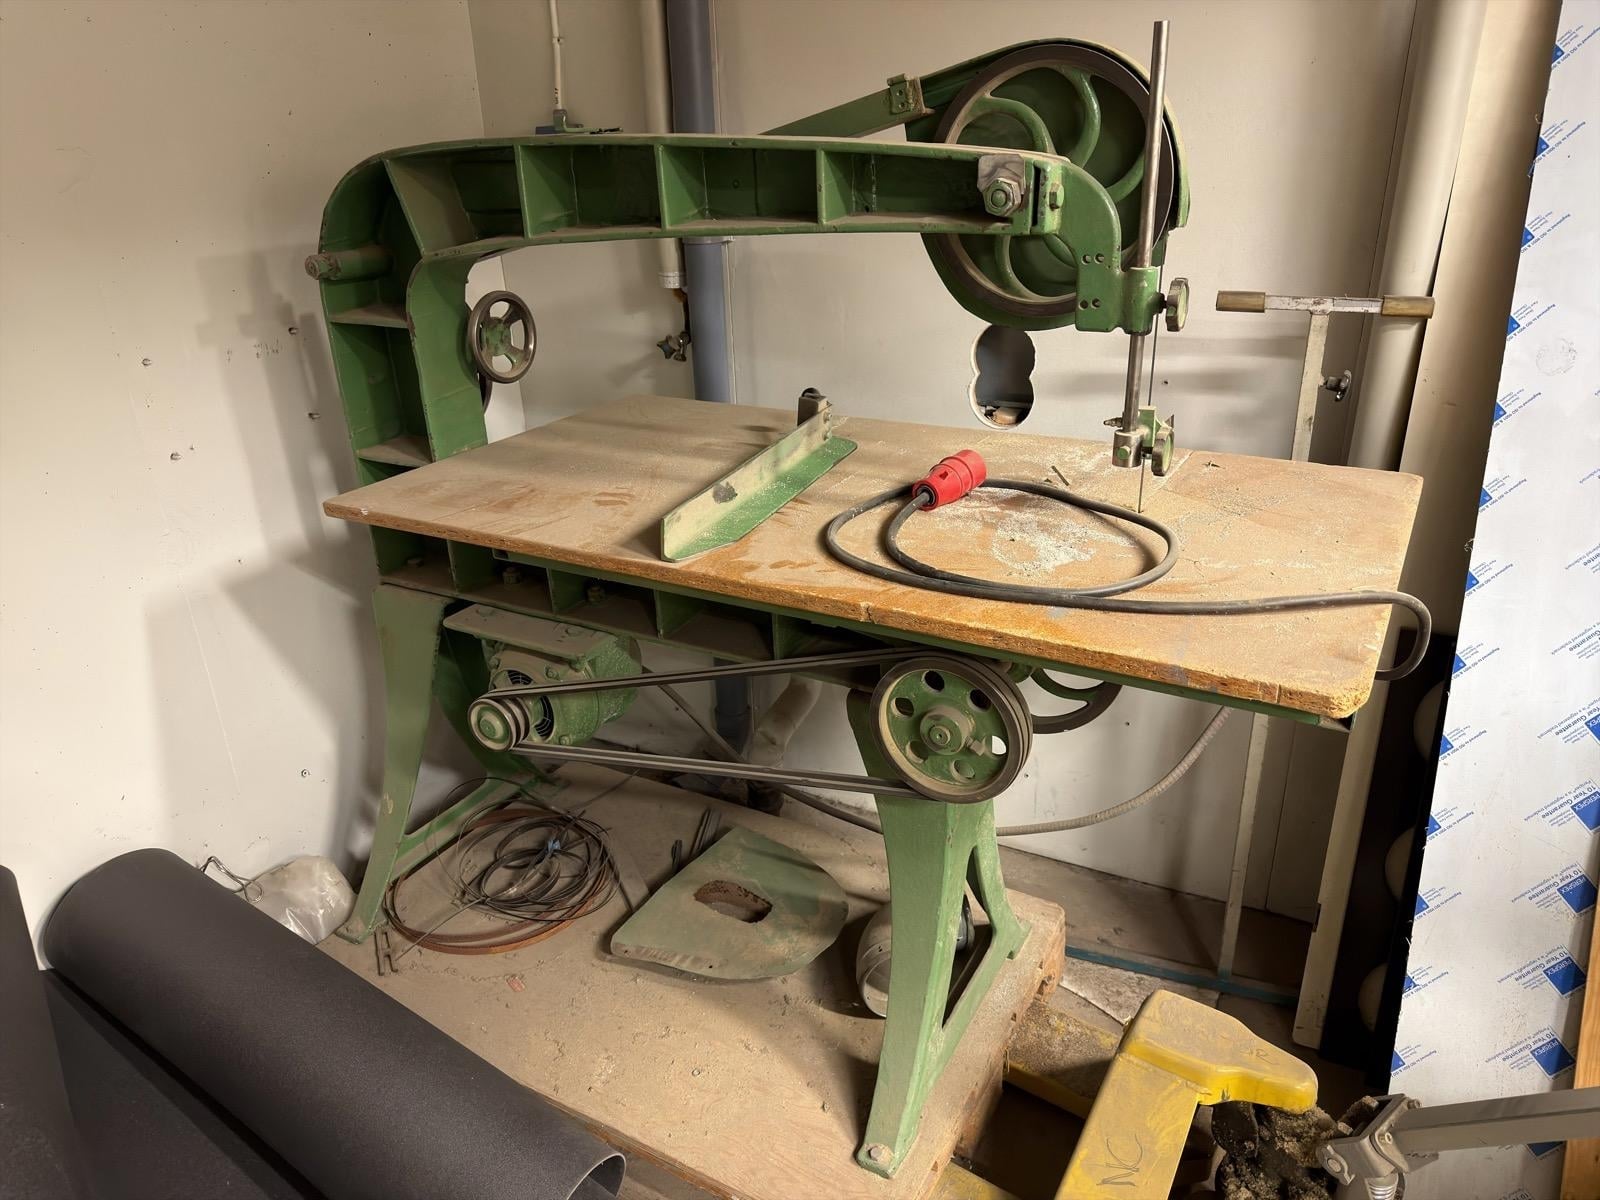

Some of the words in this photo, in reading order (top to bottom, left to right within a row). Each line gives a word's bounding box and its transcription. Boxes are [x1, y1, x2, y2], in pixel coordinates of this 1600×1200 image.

[1582, 27, 1600, 43] egistered
[1569, 630, 1600, 653] Guarantee
[1555, 715, 1587, 737] Guarantee
[1573, 790, 1587, 800] Year
[1541, 798, 1573, 820] Guarantee
[1559, 873, 1573, 883] Year
[1528, 881, 1559, 902] Guarantee
[1545, 955, 1559, 965] Year
[1515, 963, 1545, 982] Guarantee
[1532, 1036, 1546, 1046] Year
[1502, 1044, 1532, 1063] Guarantee
